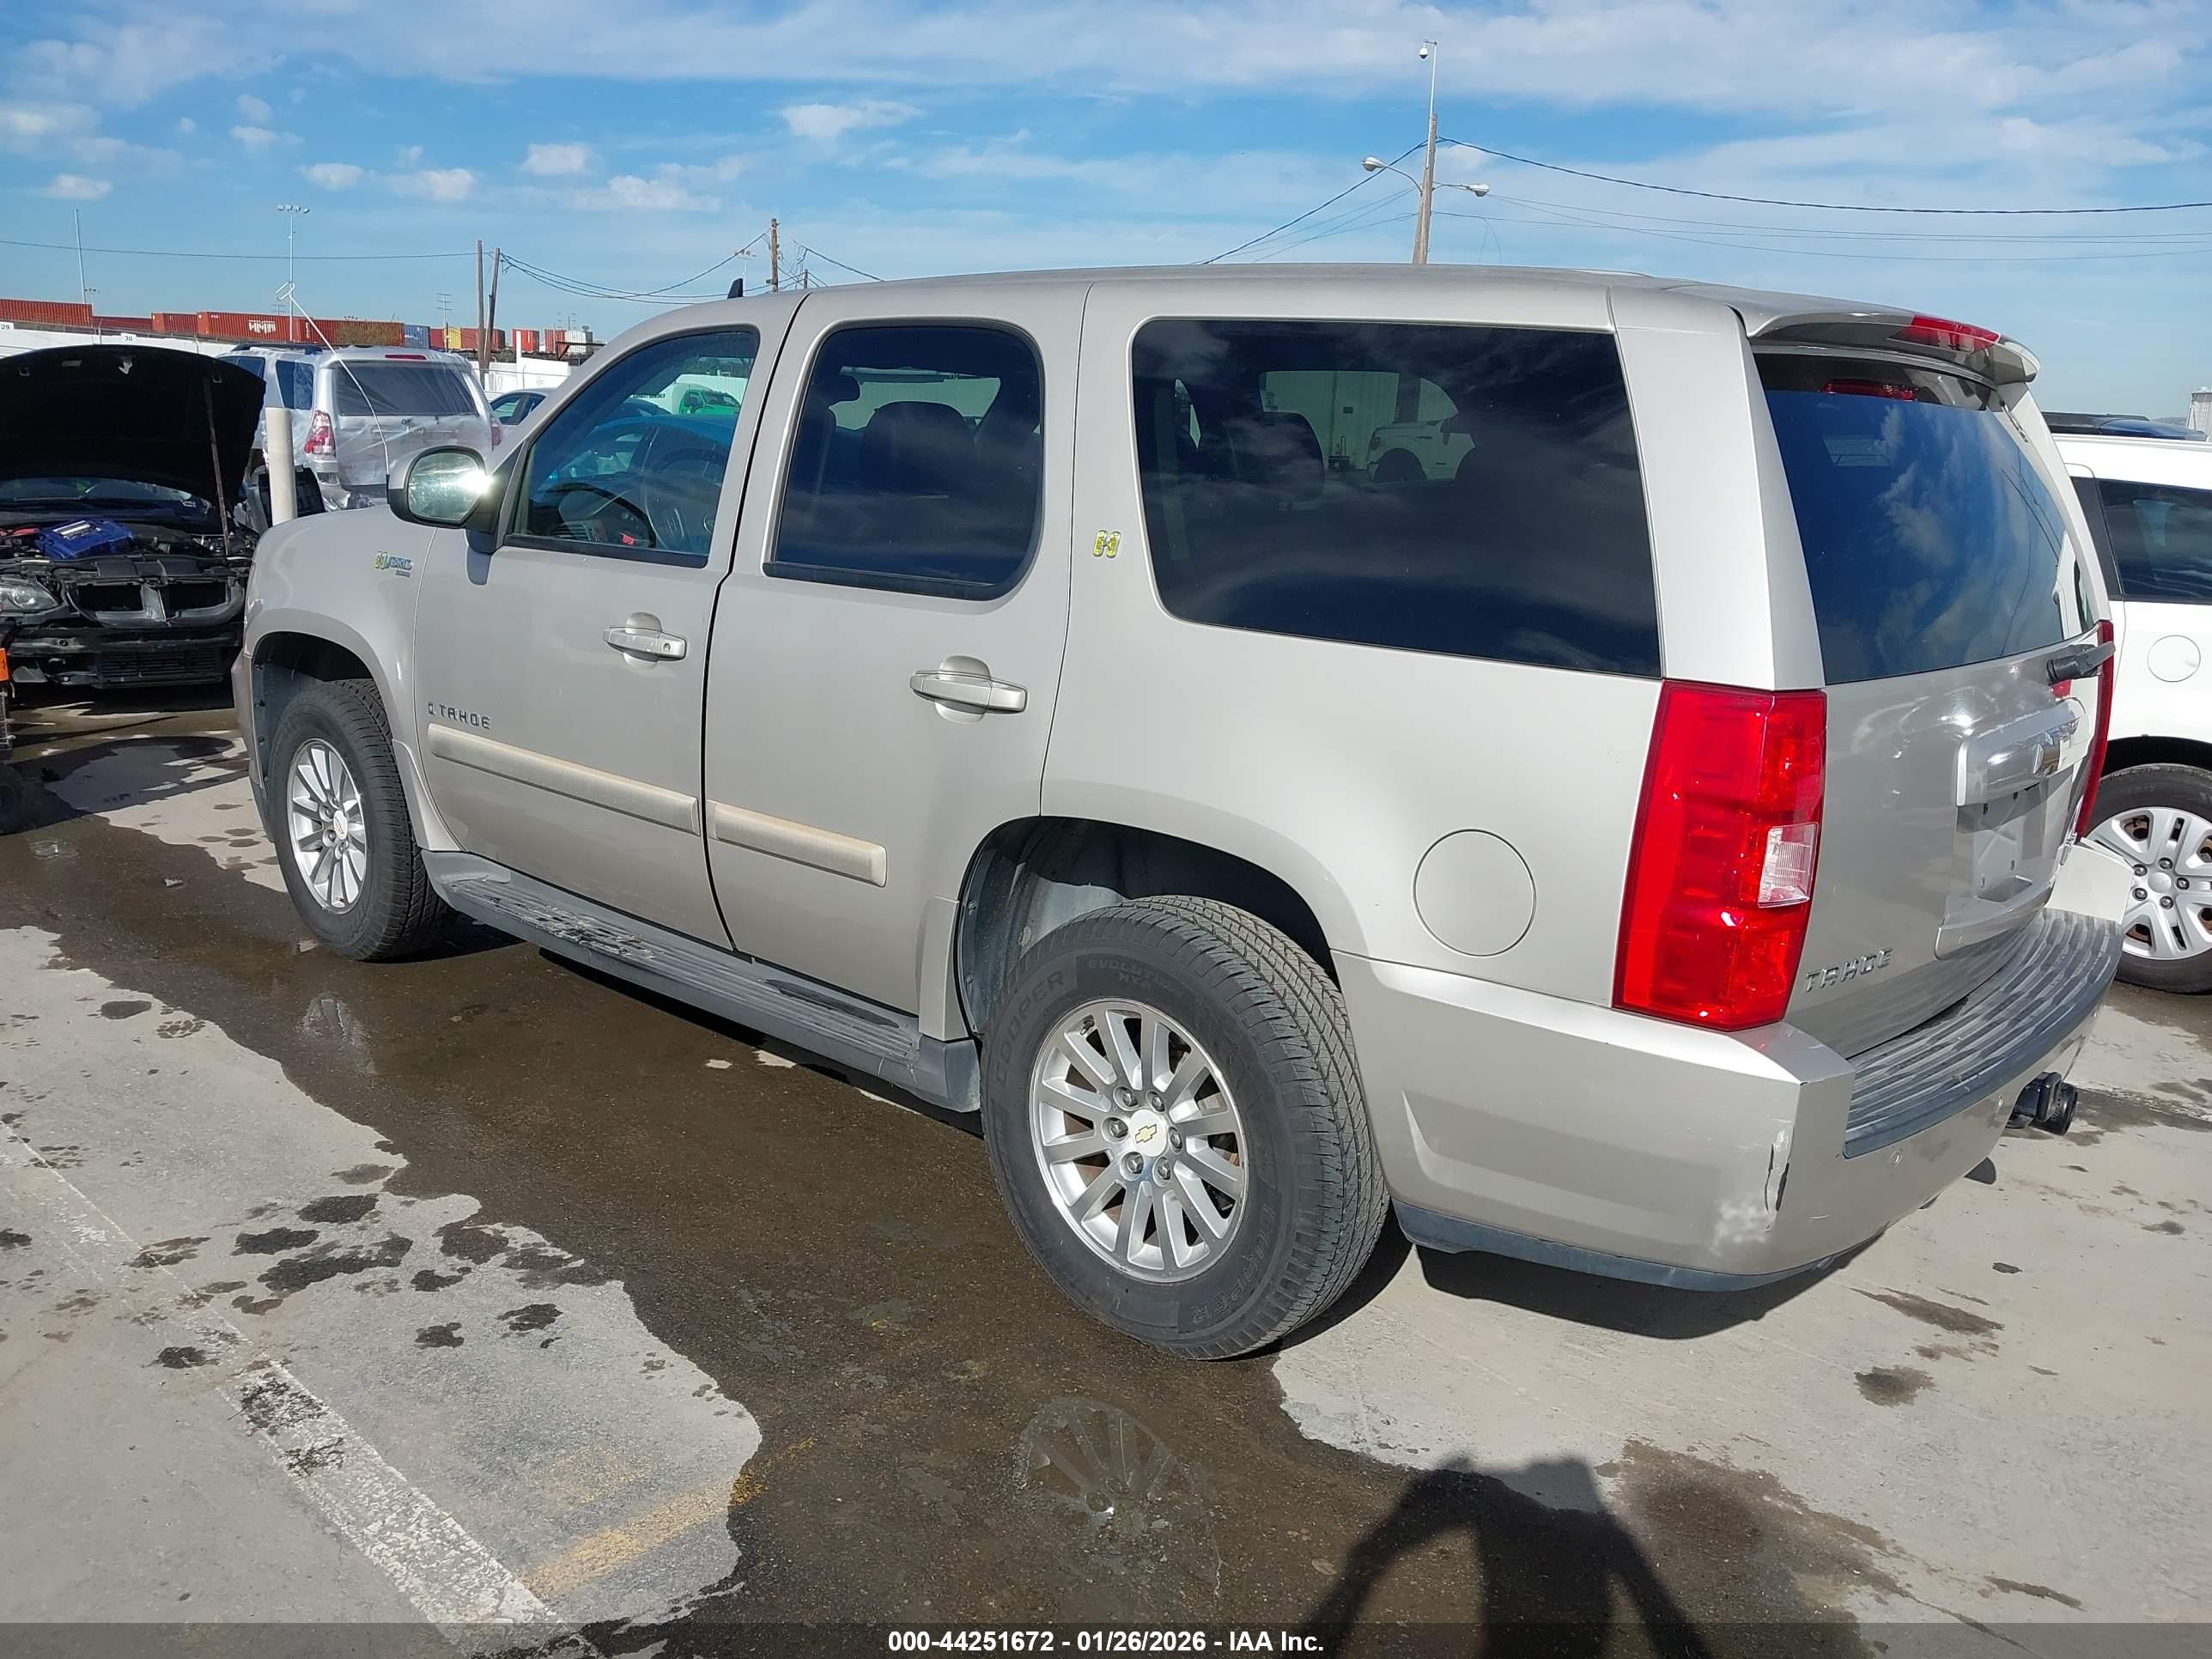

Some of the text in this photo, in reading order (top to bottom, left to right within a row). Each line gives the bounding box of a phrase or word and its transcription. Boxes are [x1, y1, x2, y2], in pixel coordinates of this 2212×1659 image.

[438, 703, 492, 731] TAHOE
[1806, 948, 1893, 993] TAHOE
[995, 970, 1066, 1086] COOPER
